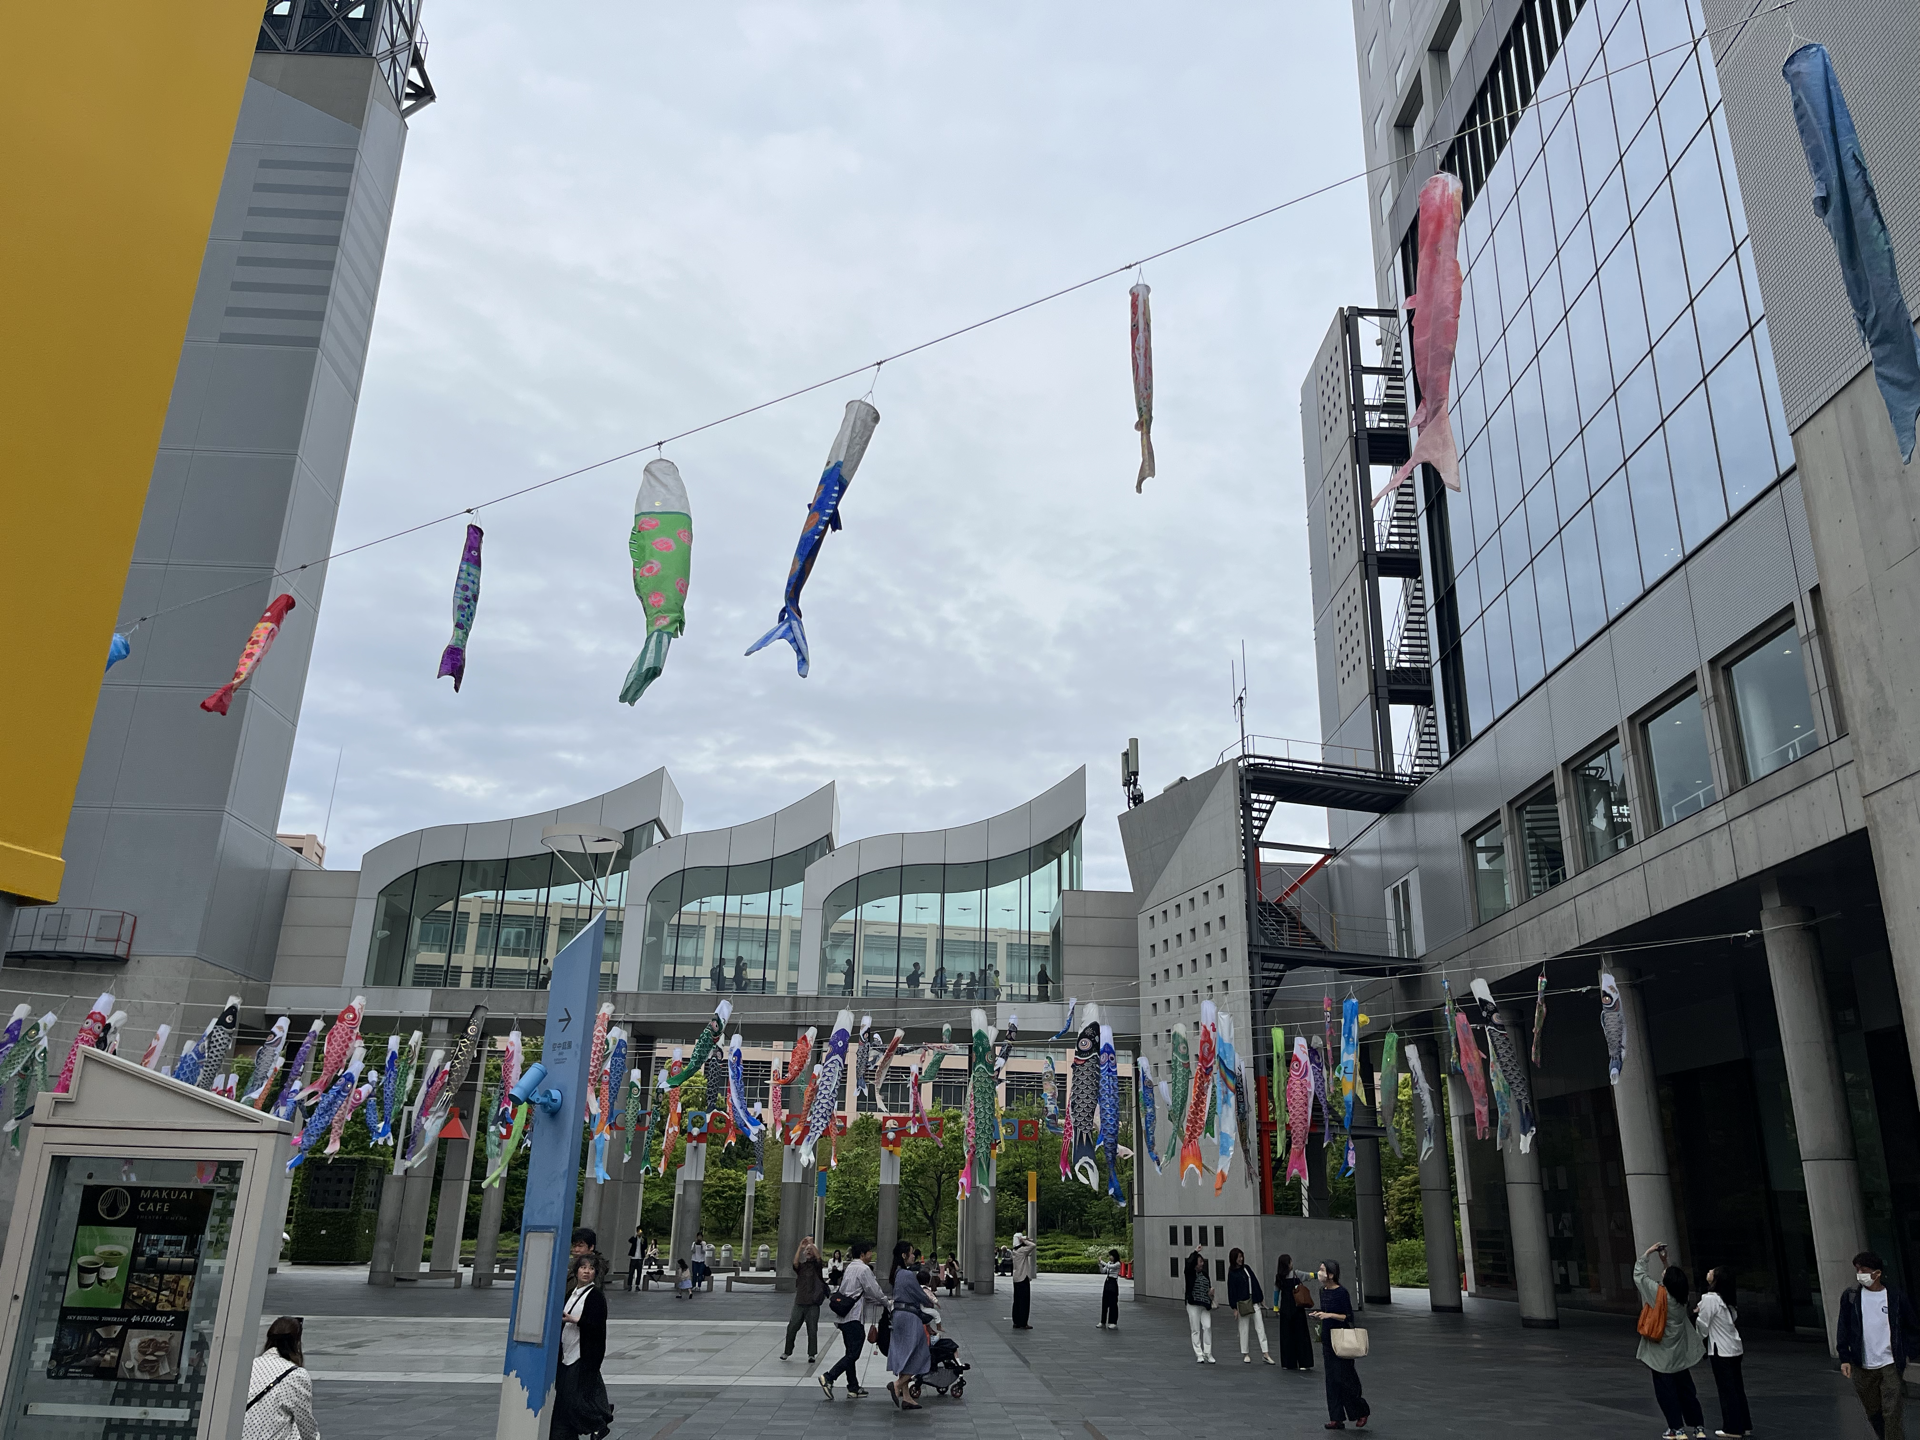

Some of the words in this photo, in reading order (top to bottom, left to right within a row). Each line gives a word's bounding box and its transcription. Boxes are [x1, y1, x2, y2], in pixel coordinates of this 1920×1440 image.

[140, 1189, 194, 1200] MAKUAI
[138, 1202, 170, 1212] CAFE
[131, 1314, 141, 1323] 4th
[140, 1315, 167, 1324] FLOOR
